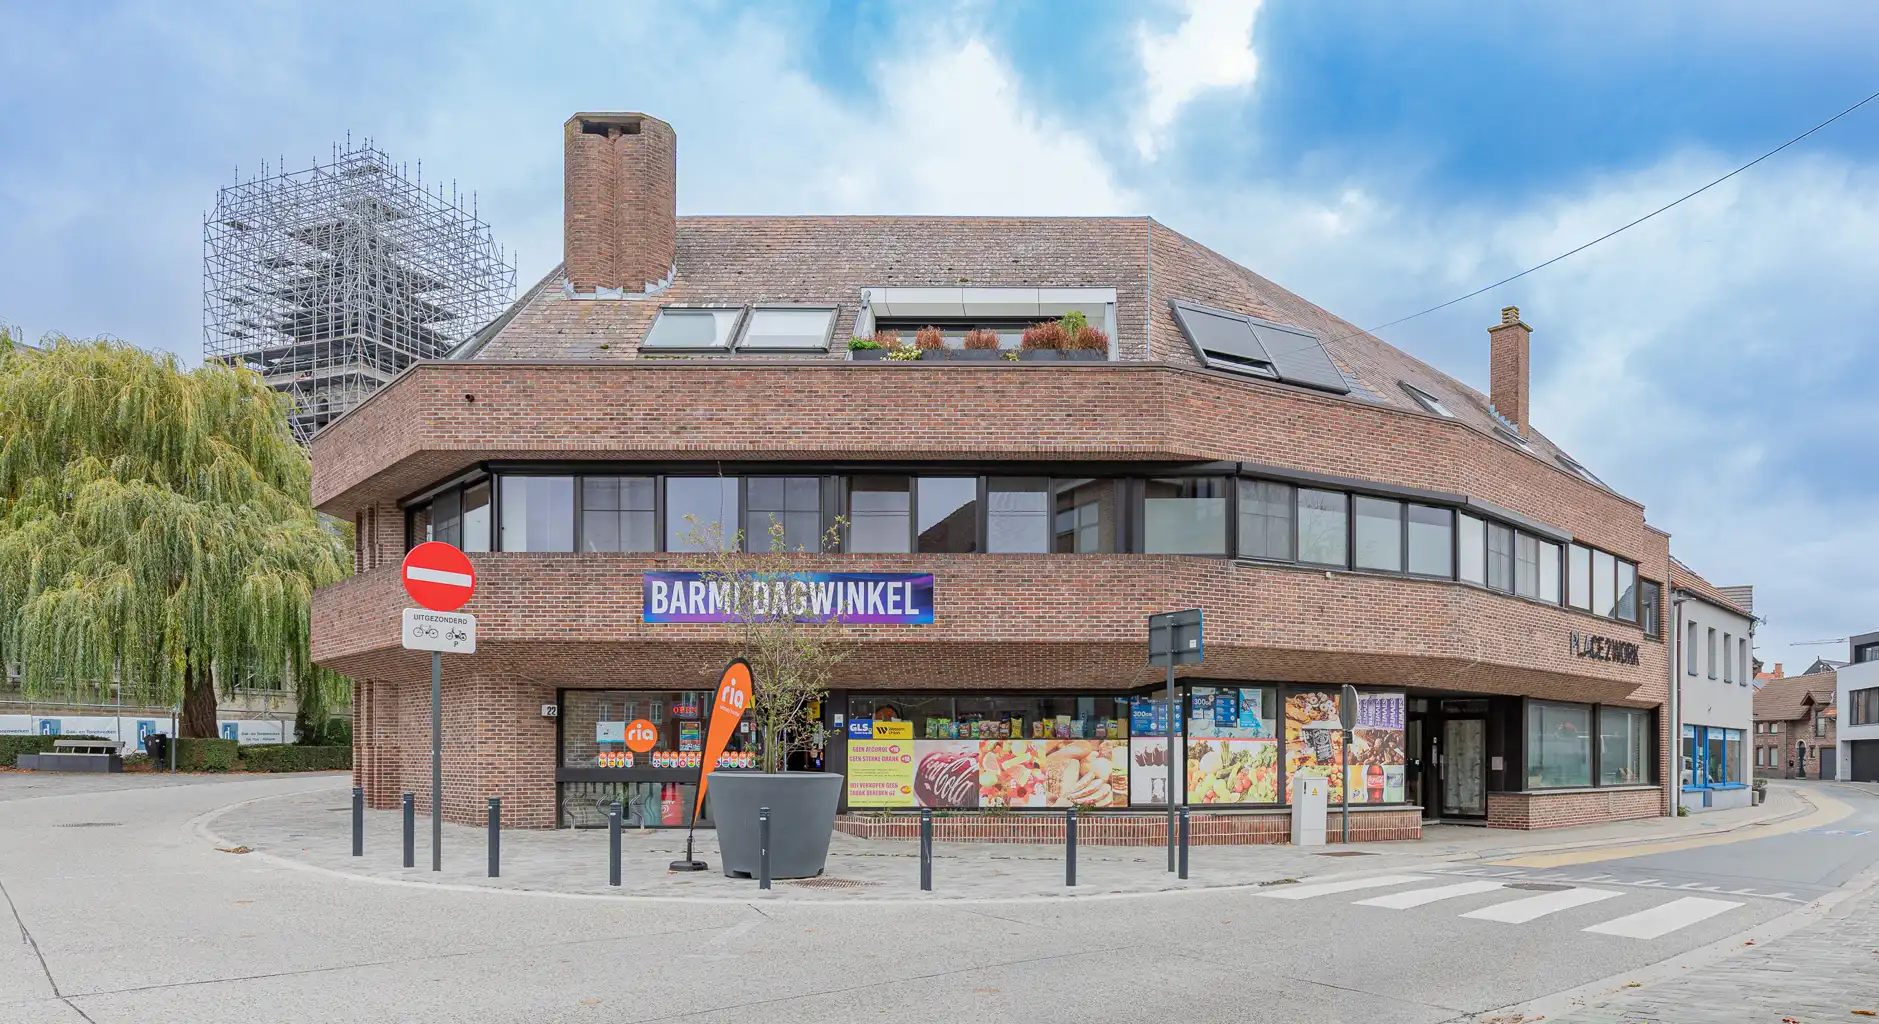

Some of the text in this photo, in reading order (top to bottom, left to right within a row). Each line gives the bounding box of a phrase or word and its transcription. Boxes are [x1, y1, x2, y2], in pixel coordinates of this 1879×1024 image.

[752, 581, 919, 615] DAGWINKEL
[413, 613, 468, 625] UITGEZONDERD
[1570, 630, 1640, 667] PLACE2WORK
[722, 677, 744, 708] ria
[546, 706, 557, 716] 22
[672, 705, 698, 714] OPEN
[628, 723, 655, 741] ria
[850, 723, 869, 732] GLS
